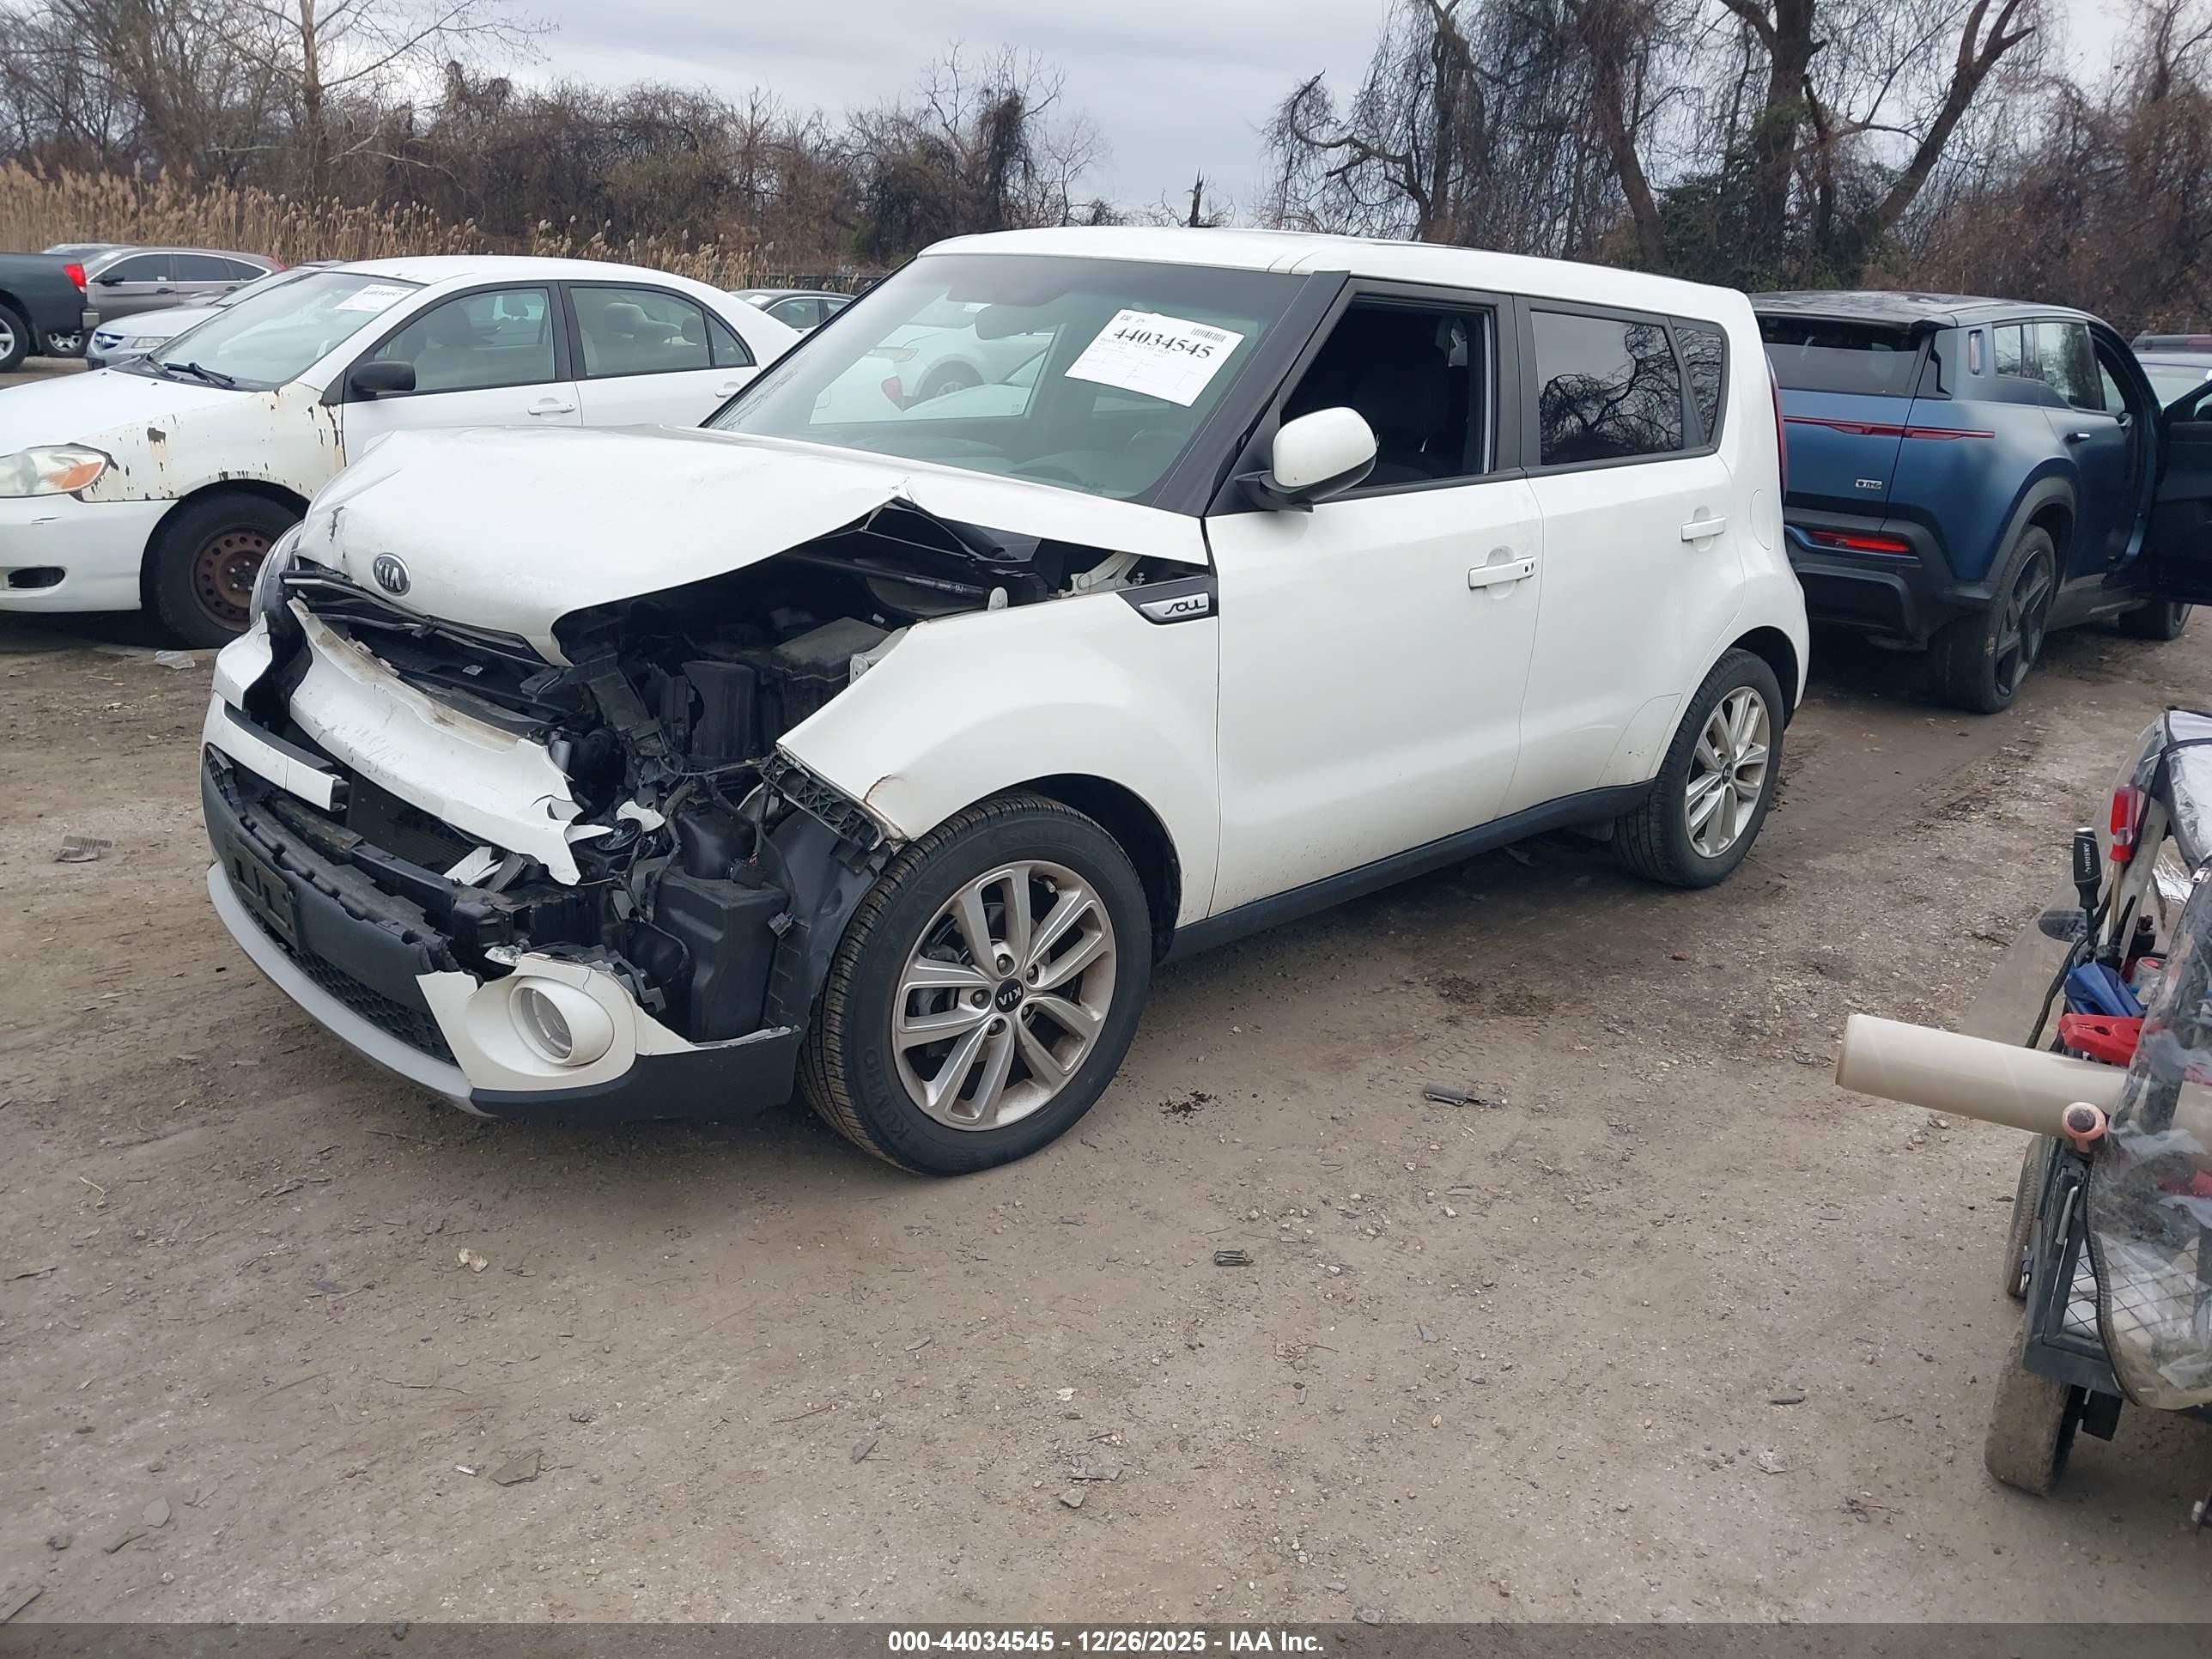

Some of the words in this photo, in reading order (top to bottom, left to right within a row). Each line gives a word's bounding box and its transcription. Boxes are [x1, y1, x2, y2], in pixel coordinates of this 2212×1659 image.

[1114, 327, 1215, 359] 44034545
[376, 560, 402, 590] KIA
[1164, 599, 1206, 615] SOUL
[2083, 843, 2092, 866] HUSKY
[998, 985, 1023, 1006] KIA
